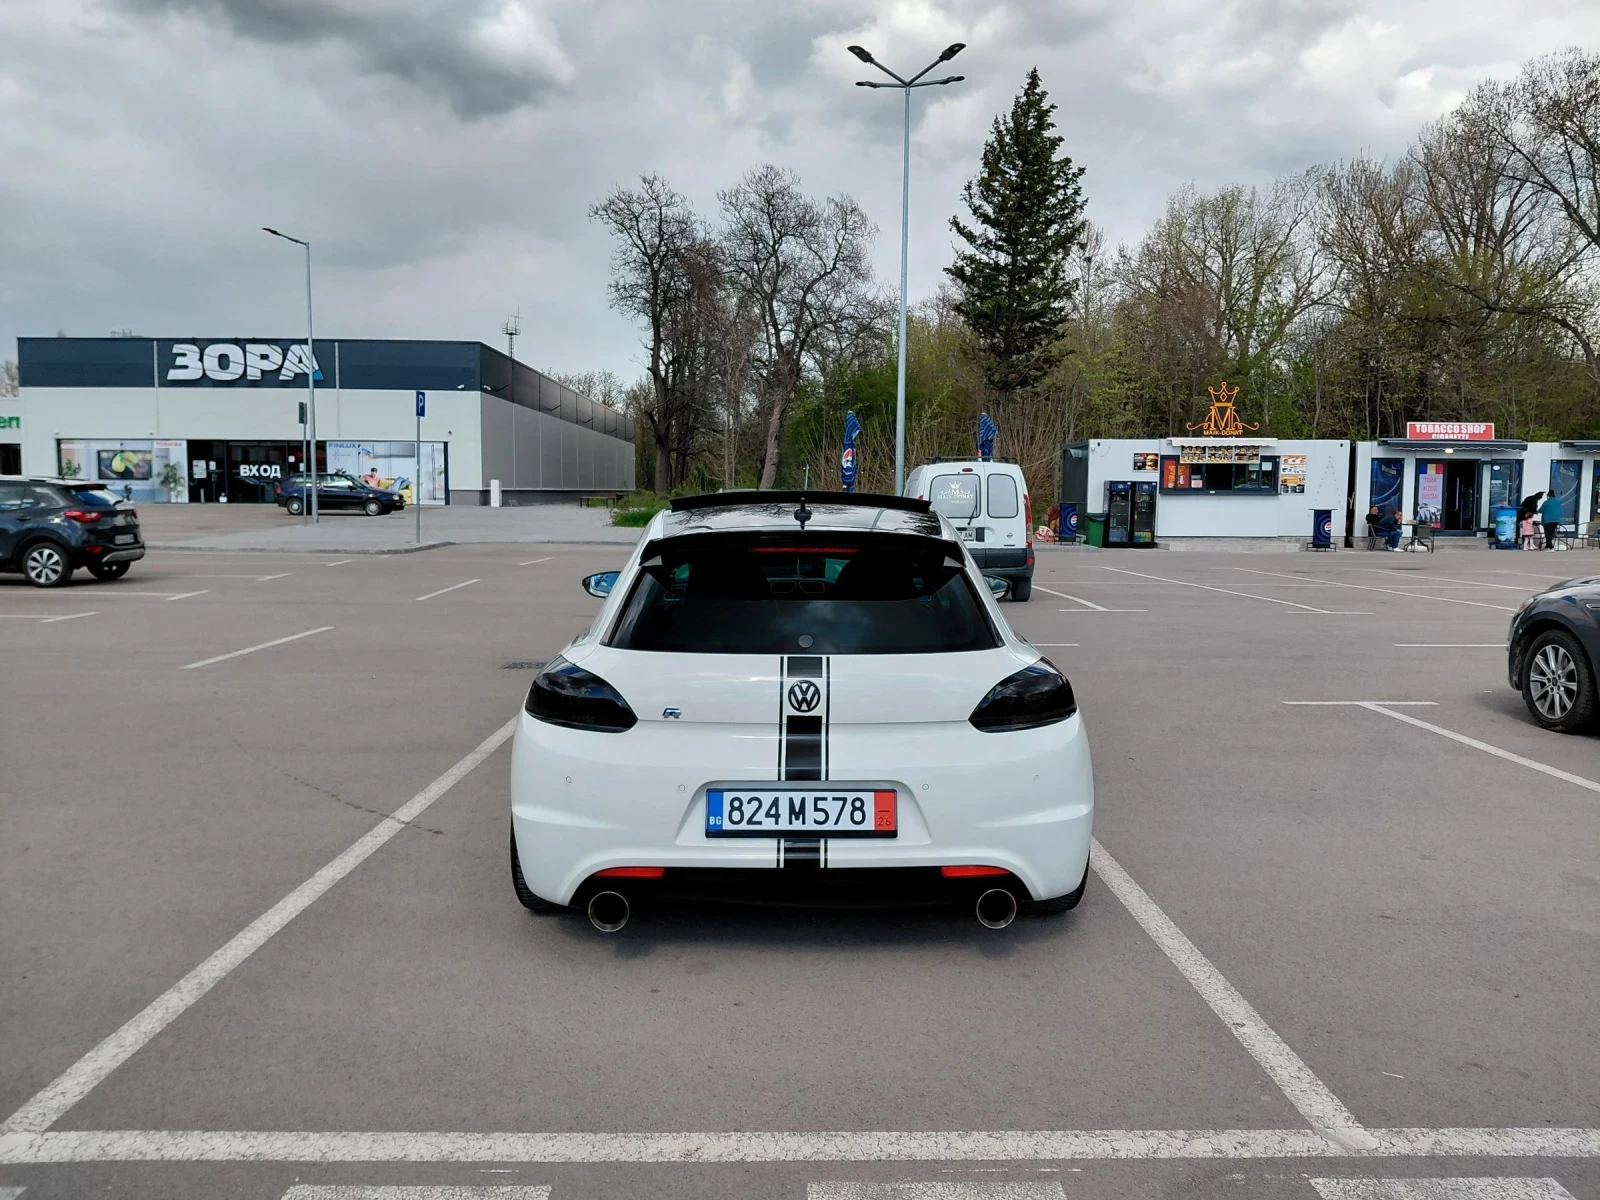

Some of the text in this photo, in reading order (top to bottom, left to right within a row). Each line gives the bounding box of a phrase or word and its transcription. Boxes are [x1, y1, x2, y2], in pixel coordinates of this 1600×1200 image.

[166, 343, 324, 381] ЗОРА
[418, 394, 424, 413] P
[1415, 424, 1487, 434] TOBACCO SHOP
[239, 464, 281, 479] ВХОД
[709, 816, 722, 825] BG
[877, 816, 892, 827] 26
